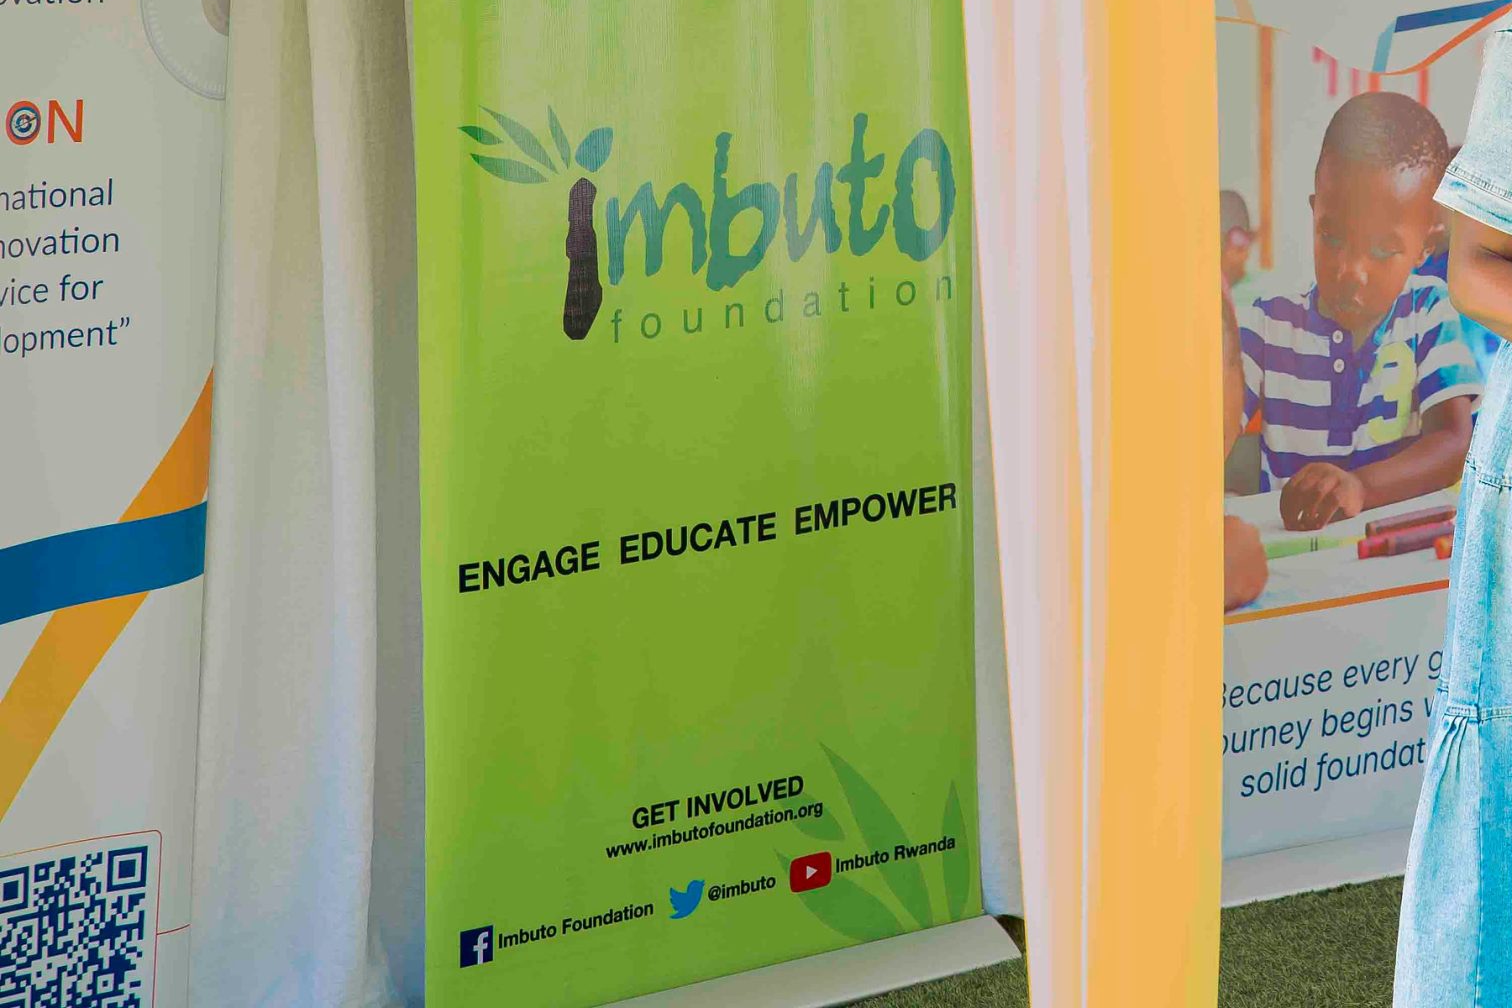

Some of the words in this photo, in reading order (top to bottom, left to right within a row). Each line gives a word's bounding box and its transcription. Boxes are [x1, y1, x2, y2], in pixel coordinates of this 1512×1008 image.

[5, 99, 84, 145] ON
[563, 112, 956, 341] imbuto
[60, 274, 103, 301] for
[610, 273, 953, 344] foundation
[0, 317, 130, 358] opment”
[458, 540, 600, 593] ENGAGE
[620, 512, 777, 565] EDUCATE
[795, 483, 957, 535] EMPOWER
[1343, 654, 1419, 688] every
[1321, 699, 1413, 738] begins
[1241, 757, 1307, 797] solid
[1314, 738, 1426, 792] foundat
[632, 800, 680, 829] GET
[687, 775, 804, 818] INVOLVED
[606, 802, 823, 858] www.imbutofoundation.org
[835, 852, 889, 873] Imbuto
[894, 836, 956, 861] Rwanda
[708, 876, 776, 901] @imbuto
[499, 925, 557, 949] Imbuto
[562, 903, 654, 934] Foundation
